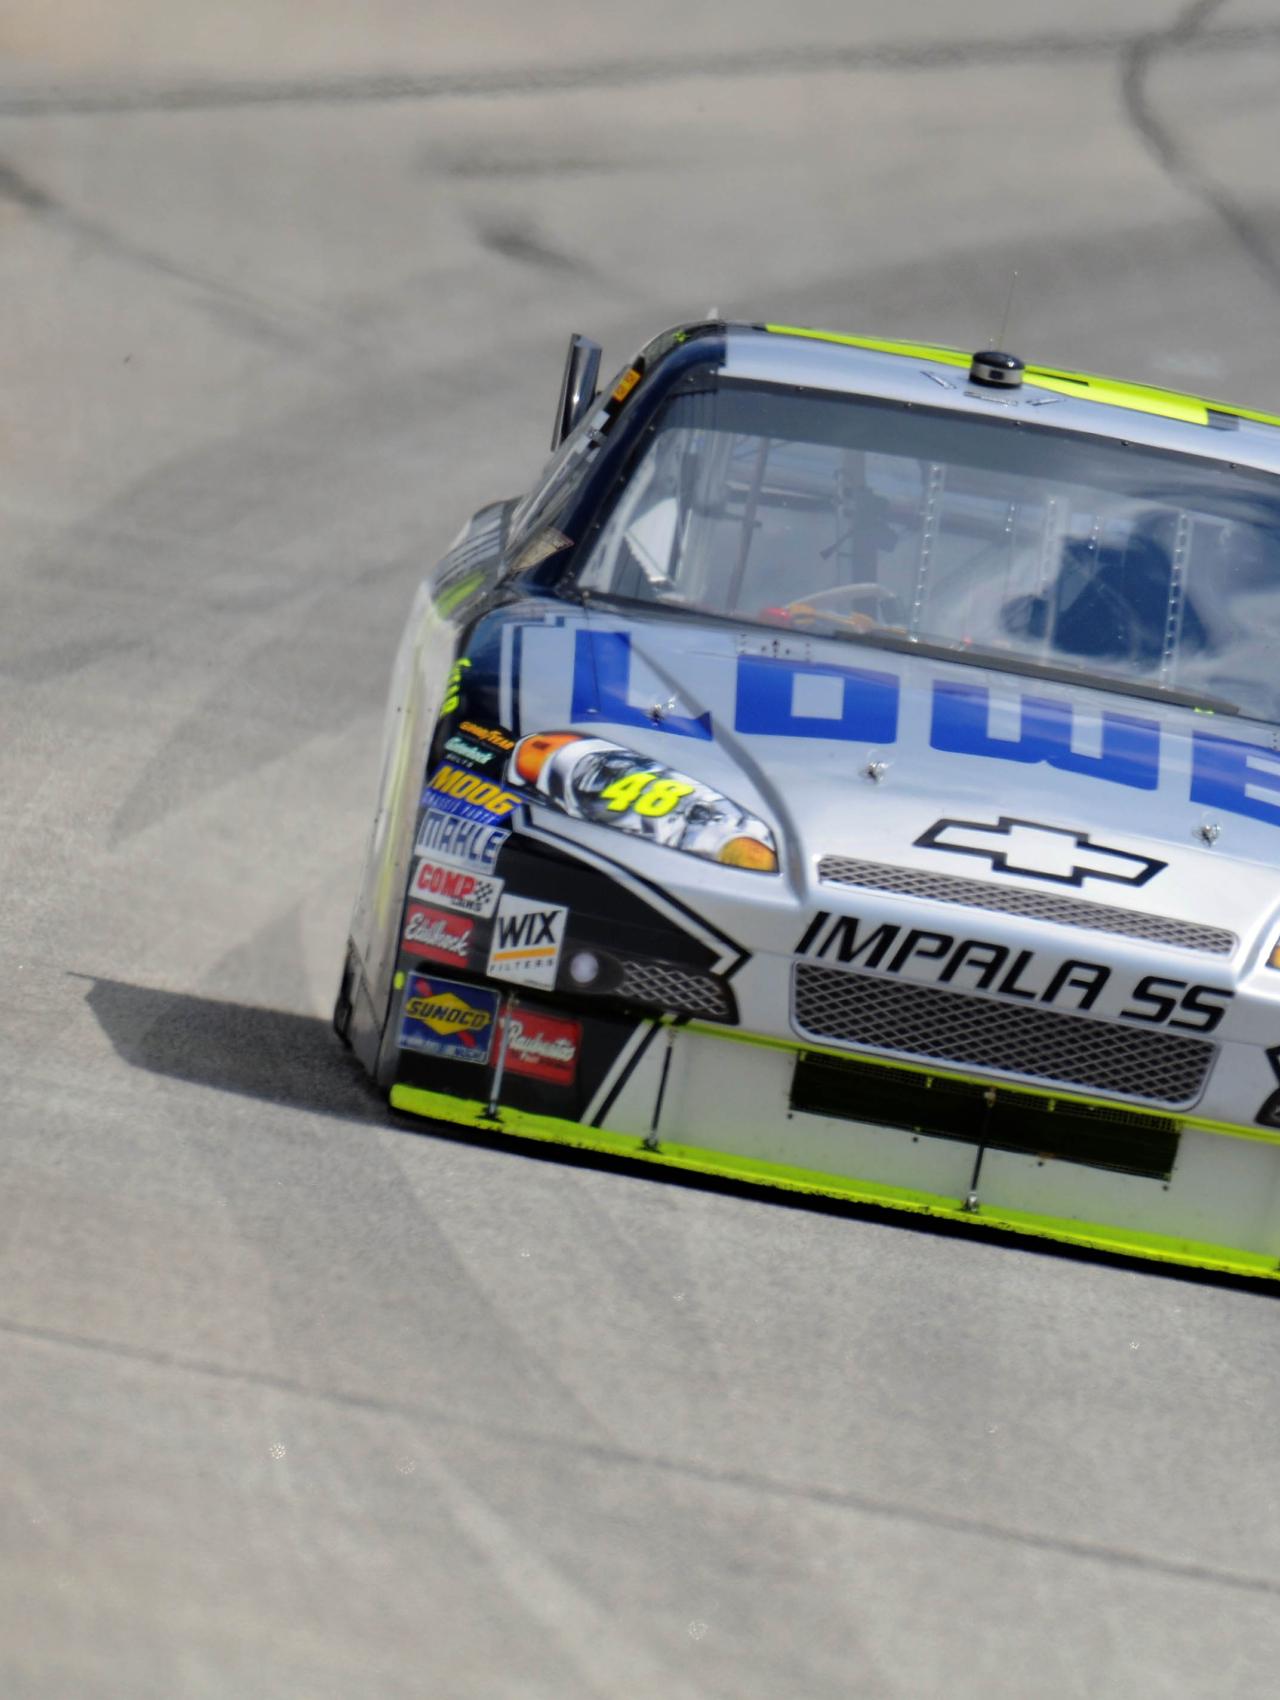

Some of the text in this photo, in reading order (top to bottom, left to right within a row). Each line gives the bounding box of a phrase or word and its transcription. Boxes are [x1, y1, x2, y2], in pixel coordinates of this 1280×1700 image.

[431, 765, 523, 815] MOOG
[601, 772, 695, 817] 48
[417, 864, 476, 901] COMP
[498, 909, 563, 950] WIX
[794, 910, 1236, 1034] IMPALA SS
[406, 999, 488, 1030] SUNOCO
